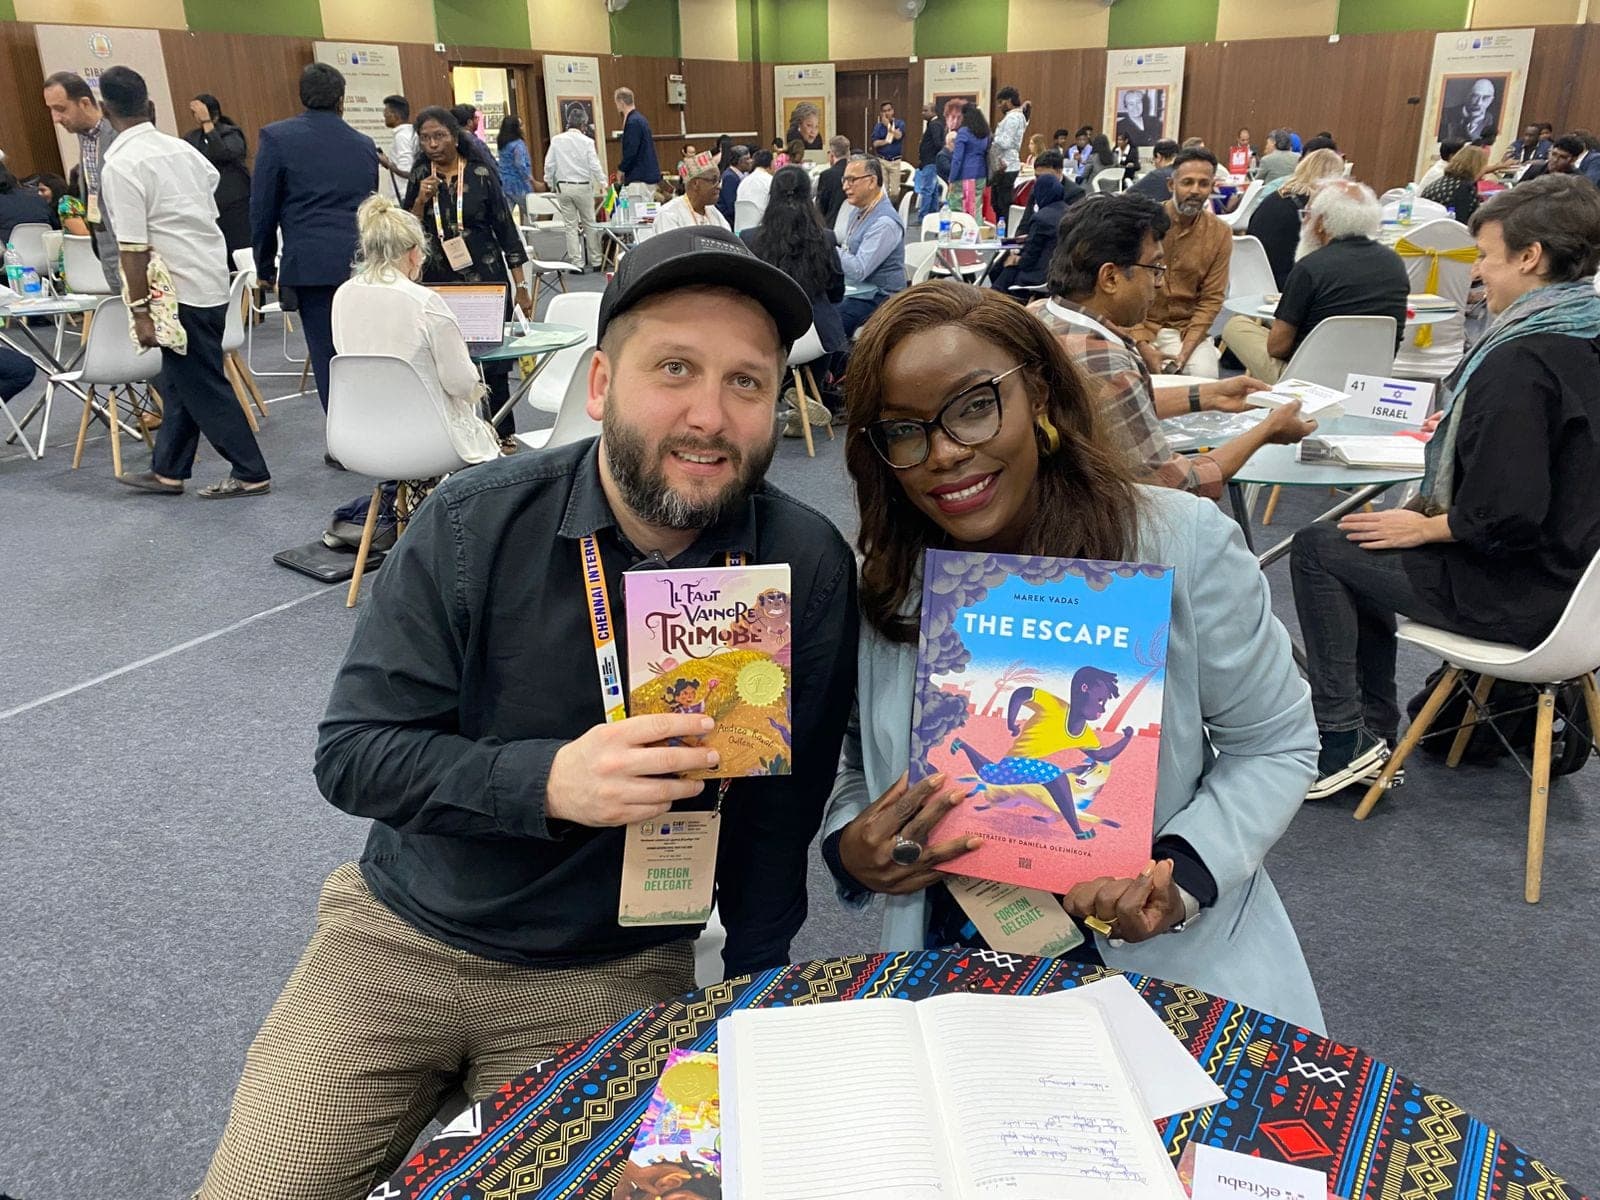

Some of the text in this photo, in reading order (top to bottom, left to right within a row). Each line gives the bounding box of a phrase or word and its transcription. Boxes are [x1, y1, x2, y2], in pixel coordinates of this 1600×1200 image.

[1351, 380, 1366, 391] 41
[1371, 406, 1409, 420] ISRAEL
[681, 577, 721, 604] FAUT
[1013, 593, 1080, 605] MAREK VADAS
[591, 587, 610, 641] CHENNAI
[680, 601, 758, 626] VAINCRE
[645, 611, 762, 659] TRIMOBE
[963, 612, 1130, 649] THE ESCAPE
[1018, 840, 1048, 849] DANIELA
[644, 879, 693, 891] DELEGATE
[647, 867, 690, 879] FOREIGN
[993, 896, 1031, 923] FOREIGN
[1000, 905, 1045, 937] DELEGATE
[1218, 1174, 1281, 1199] eKitabu
